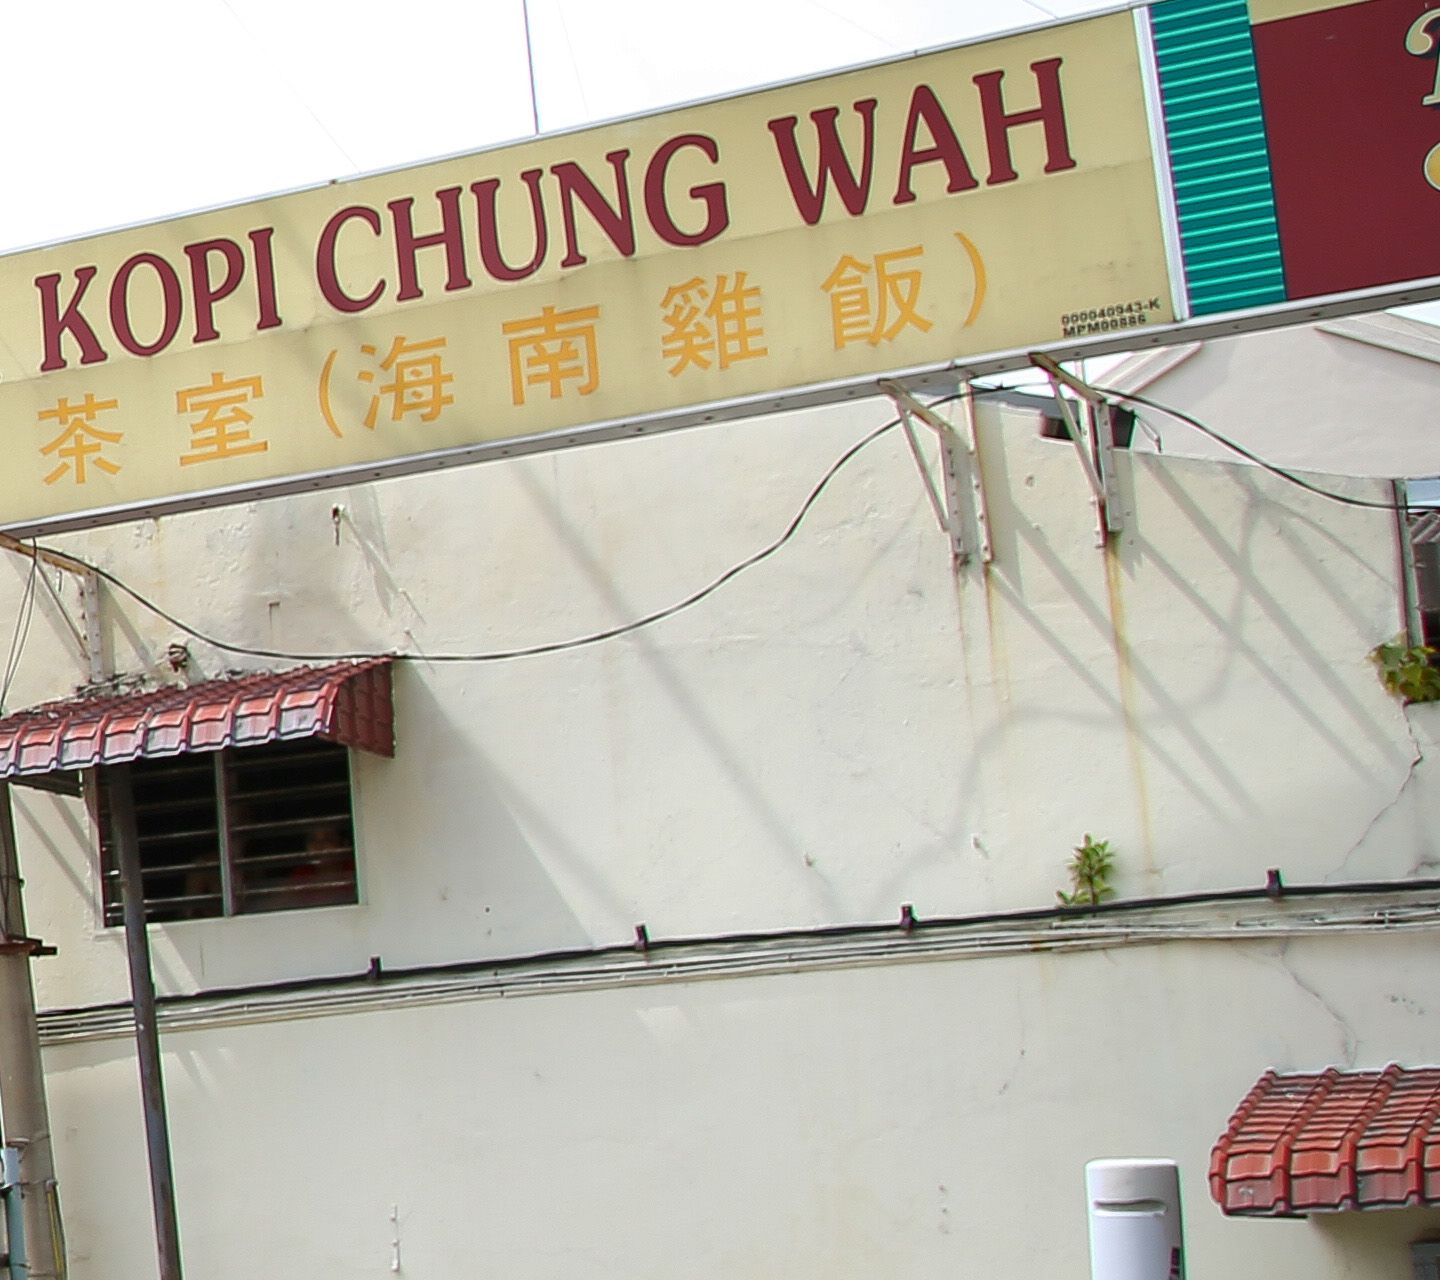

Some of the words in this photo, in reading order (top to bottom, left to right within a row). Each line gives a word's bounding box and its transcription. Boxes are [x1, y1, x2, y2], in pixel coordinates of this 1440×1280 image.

[34, 224, 282, 373] KOPI
[313, 133, 730, 314] CHUNG
[765, 55, 1079, 228] WAH
